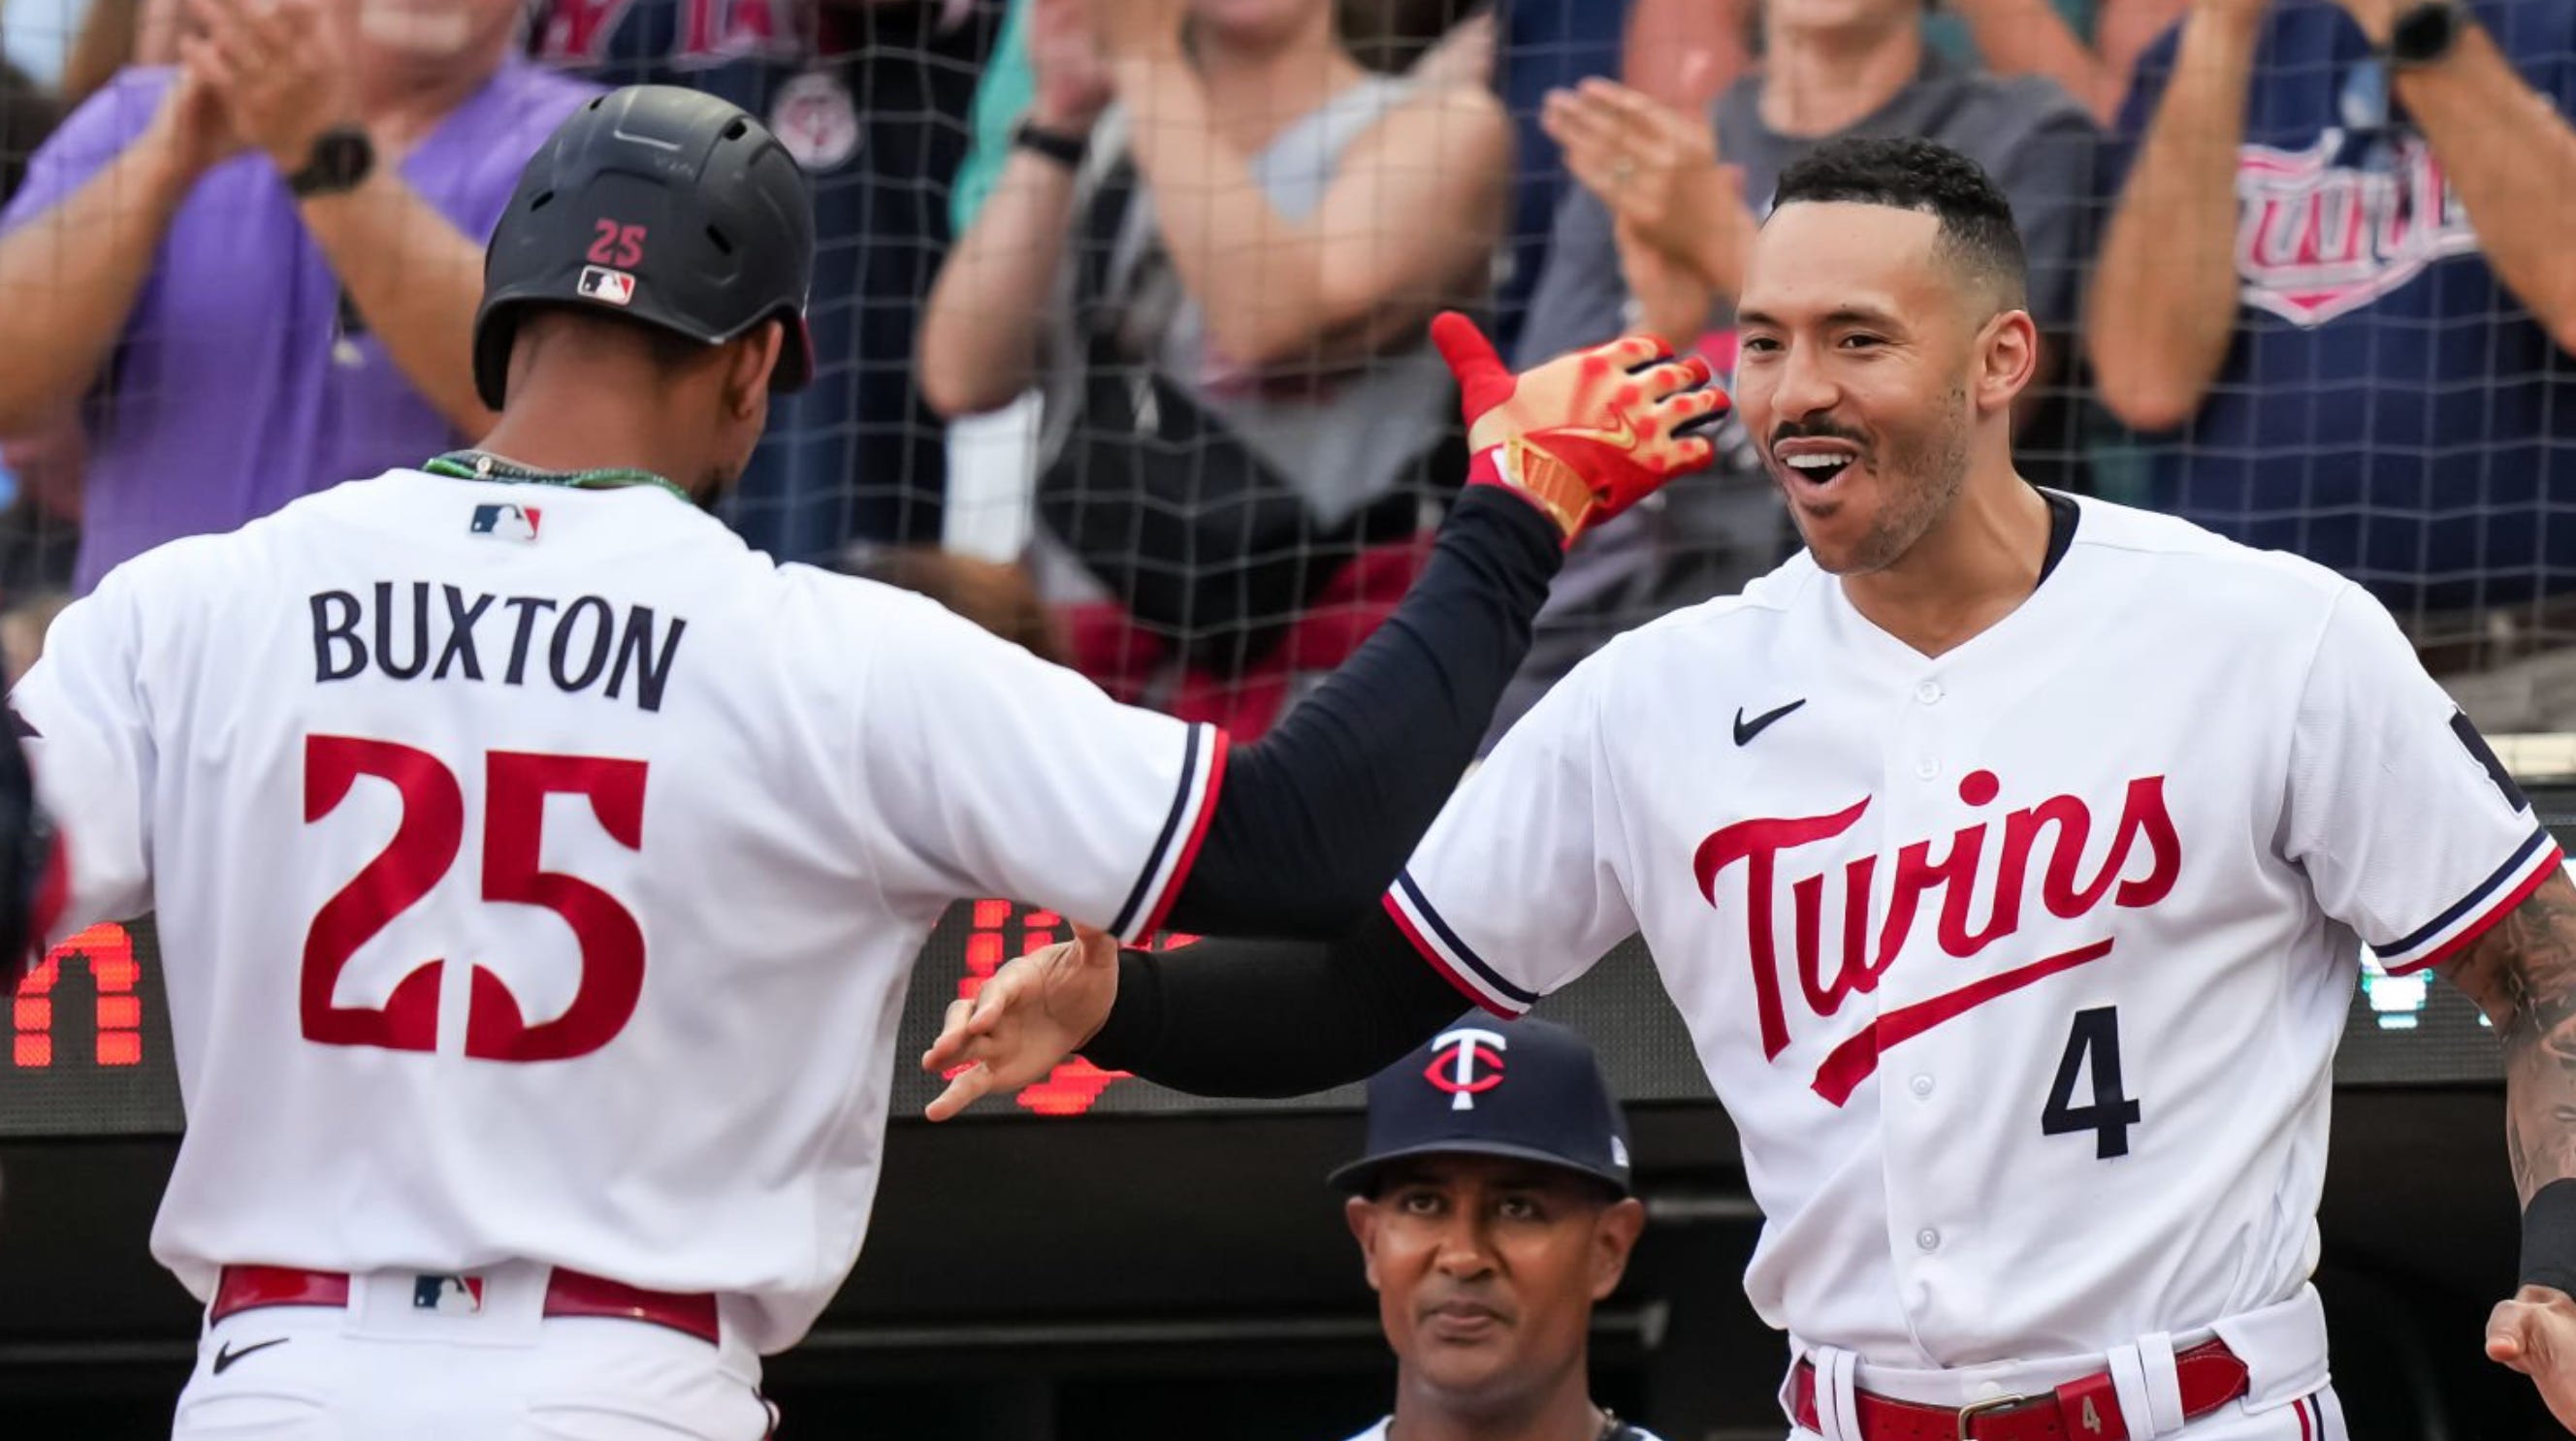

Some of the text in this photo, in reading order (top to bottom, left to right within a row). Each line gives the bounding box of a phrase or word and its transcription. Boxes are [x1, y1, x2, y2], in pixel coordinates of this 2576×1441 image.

[587, 217, 648, 269] 25
[309, 582, 687, 713] BUXTON
[300, 734, 649, 1062] 25
[1693, 770, 2181, 1064] Twins
[2042, 1005, 2141, 1160] 4
[2081, 1394, 2102, 1435] 4
